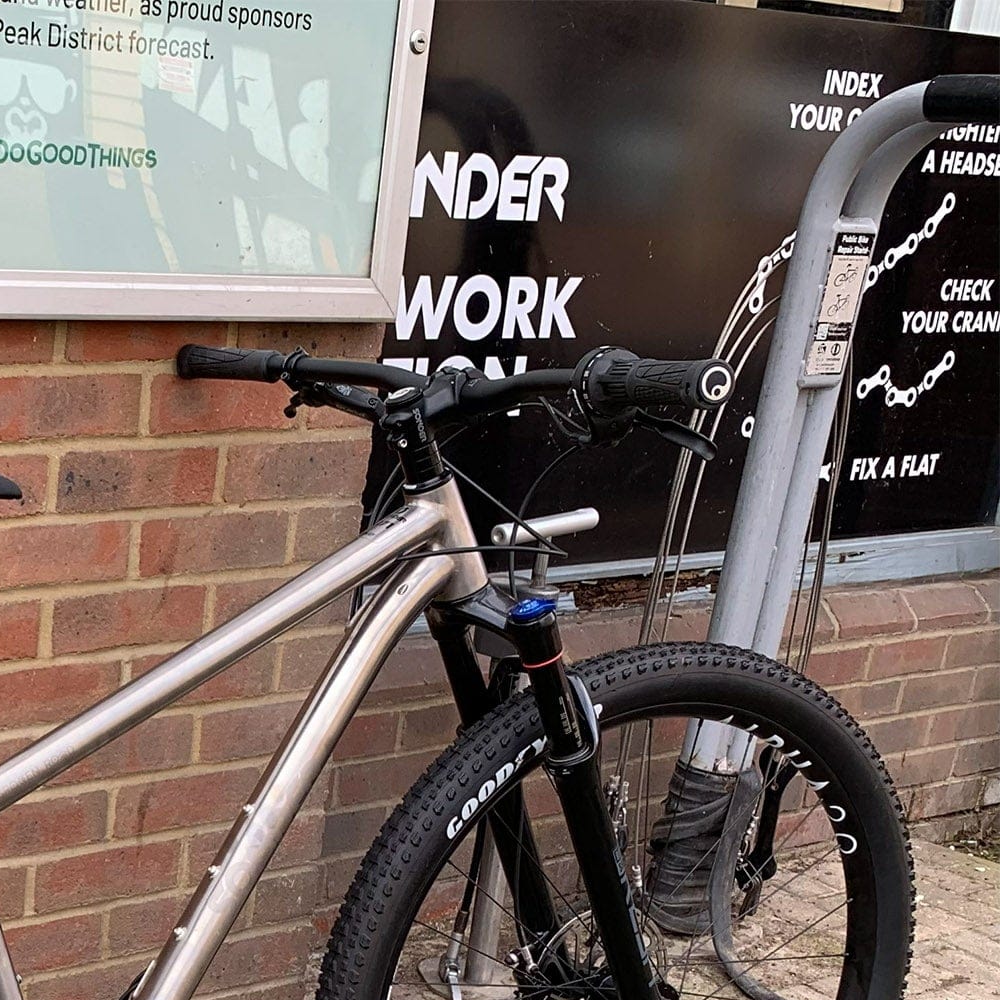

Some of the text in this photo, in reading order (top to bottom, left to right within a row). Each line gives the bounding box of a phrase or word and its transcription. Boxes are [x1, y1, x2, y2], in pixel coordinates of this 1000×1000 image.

[140, 0, 162, 16] as
[167, 0, 224, 23] proud
[228, 6, 312, 30] sponsors
[48, 23, 123, 52] District
[129, 30, 214, 60] forecast.
[822, 69, 884, 98] INDEX
[789, 103, 844, 132] YOUR
[921, 149, 935, 173] A
[940, 279, 995, 301] CHECK
[395, 274, 583, 341] WORK
[902, 310, 1000, 334] YOUR CRAN
[412, 407, 427, 443] SONDER
[849, 453, 940, 481] FIX A FLAT
